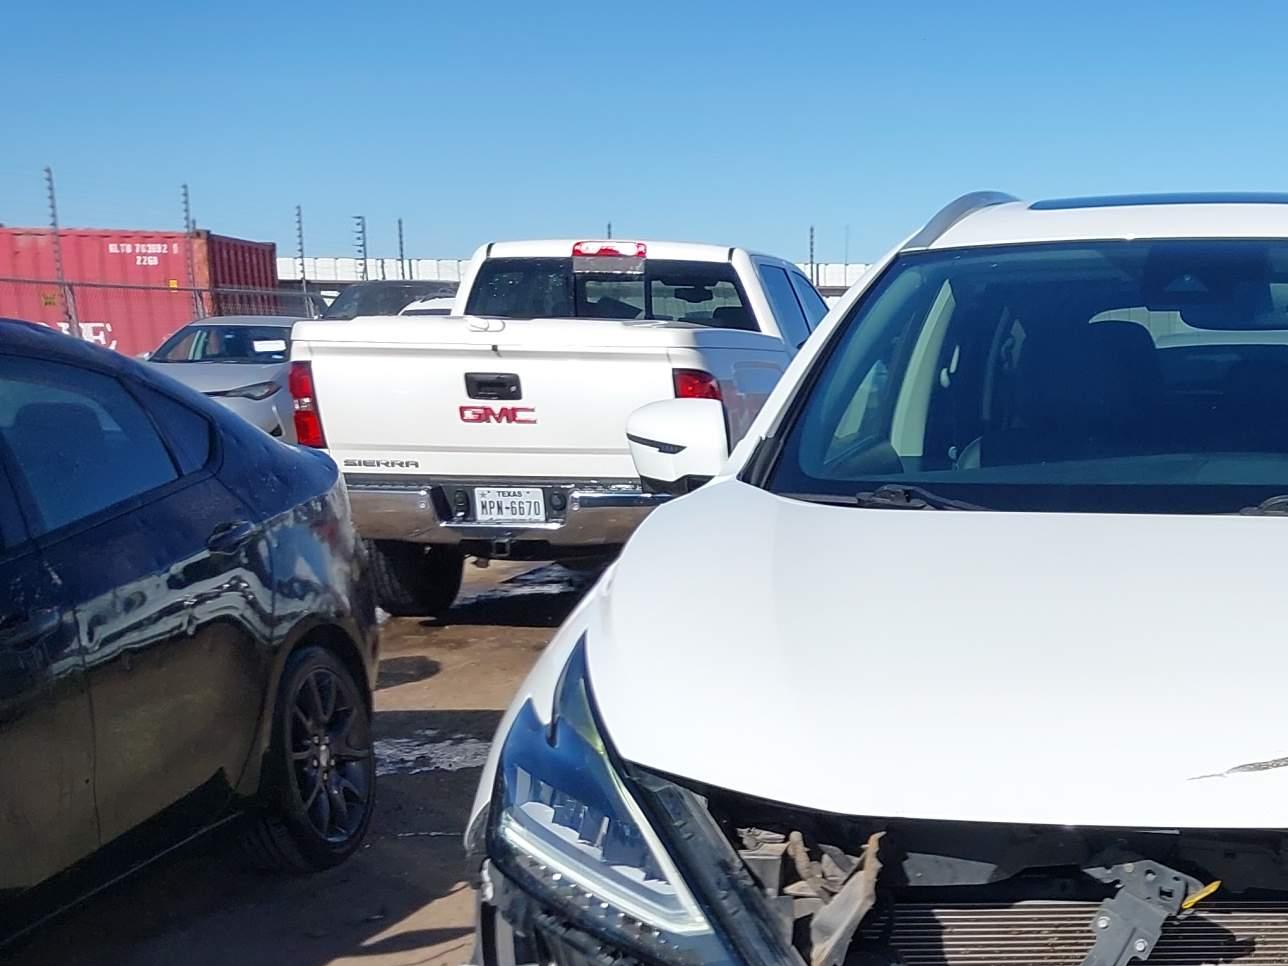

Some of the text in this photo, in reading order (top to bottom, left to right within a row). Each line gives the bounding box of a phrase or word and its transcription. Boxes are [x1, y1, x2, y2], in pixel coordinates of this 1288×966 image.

[459, 406, 537, 424] GMC
[344, 459, 420, 468] SIERRA
[497, 490, 523, 498] TEXAS
